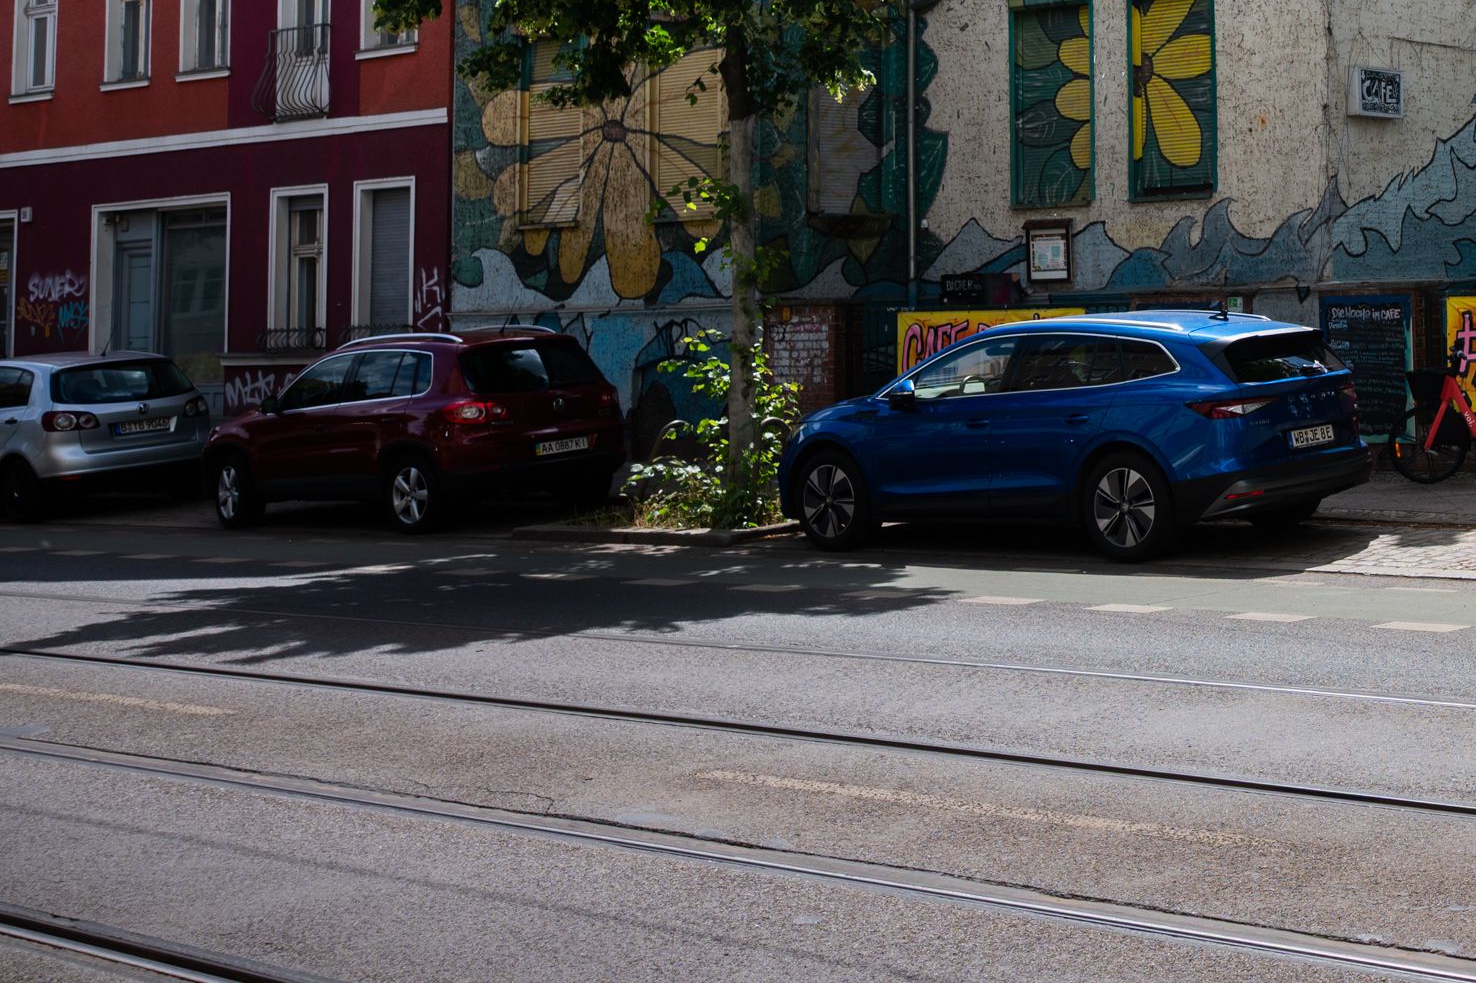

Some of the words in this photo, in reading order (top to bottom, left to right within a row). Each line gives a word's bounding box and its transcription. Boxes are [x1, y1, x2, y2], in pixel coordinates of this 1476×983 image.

[1293, 430, 1305, 444] WB
[1309, 428, 1320, 442] JE
[543, 443, 554, 453] AA
